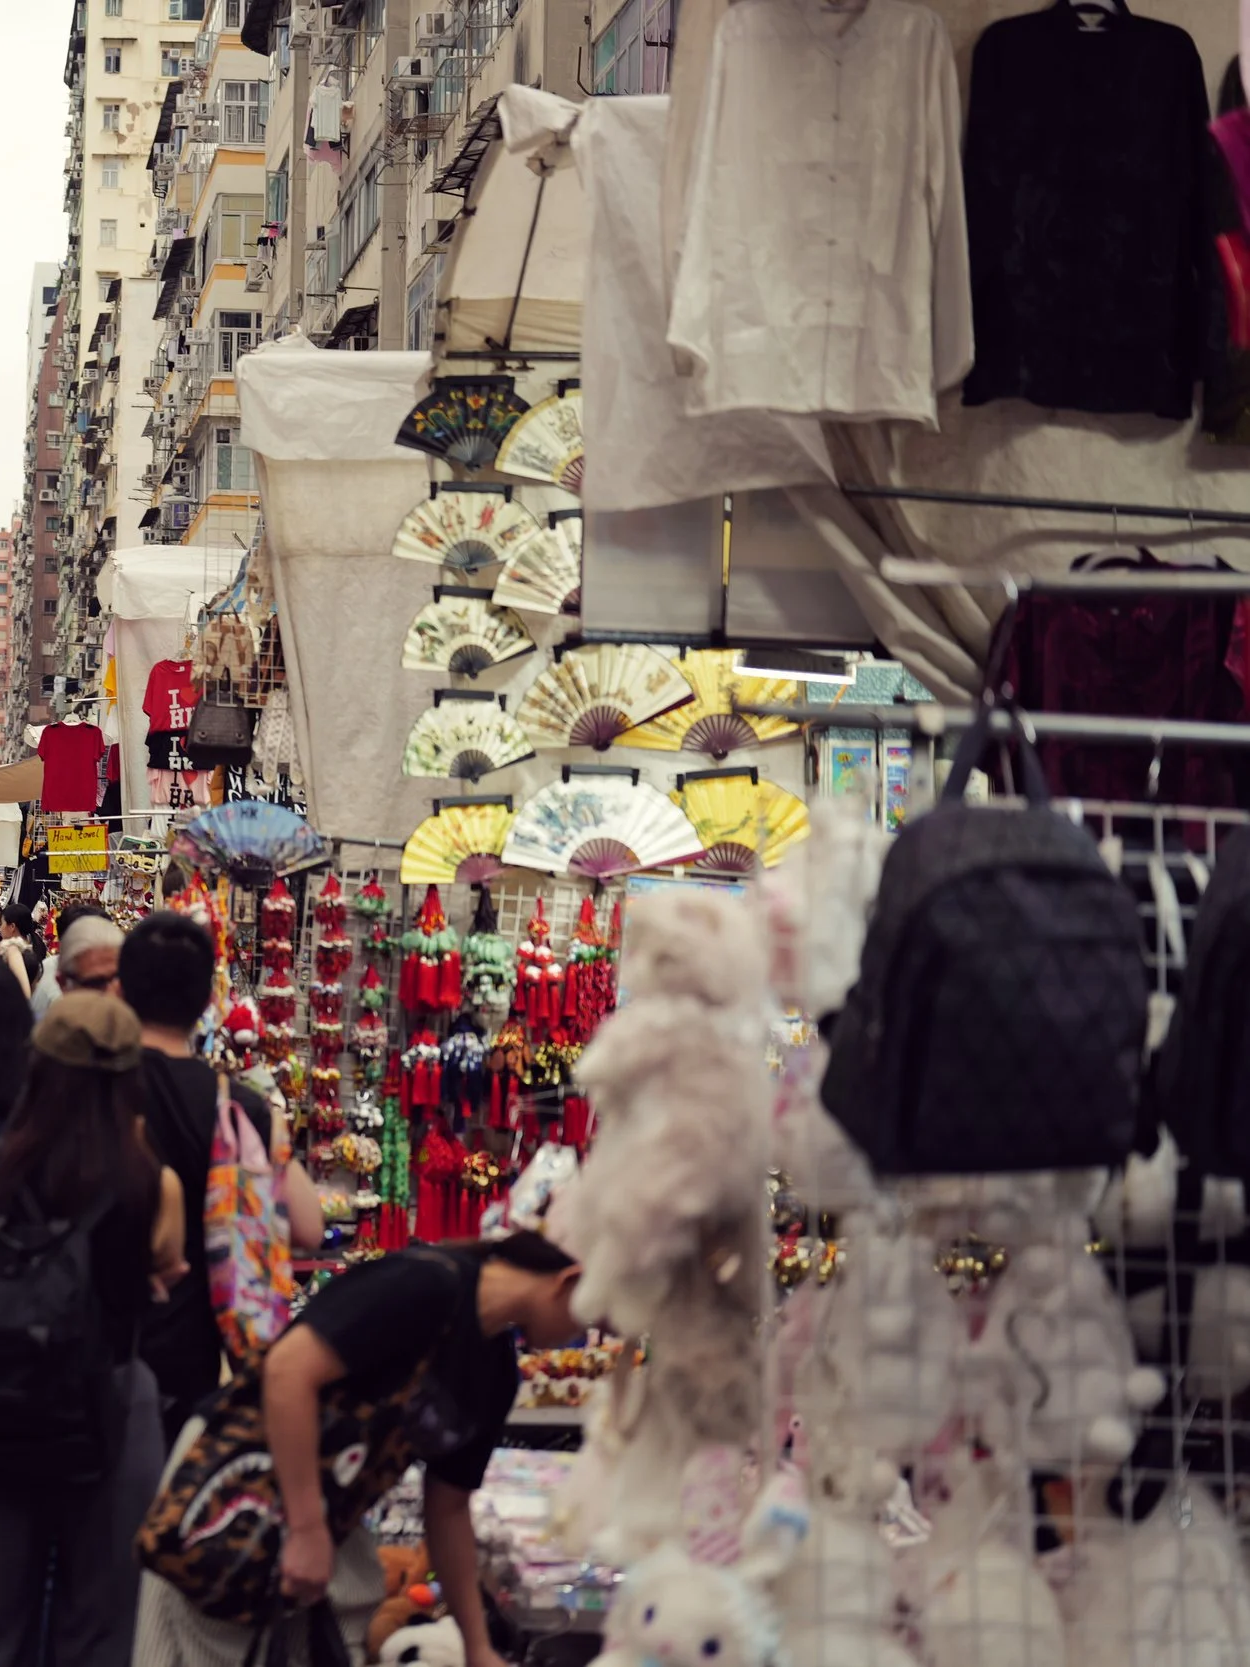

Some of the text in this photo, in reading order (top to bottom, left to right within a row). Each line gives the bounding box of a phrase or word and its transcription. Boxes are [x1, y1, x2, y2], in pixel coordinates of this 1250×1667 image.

[168, 689, 181, 709] I
[52, 828, 100, 842] Hand towel
